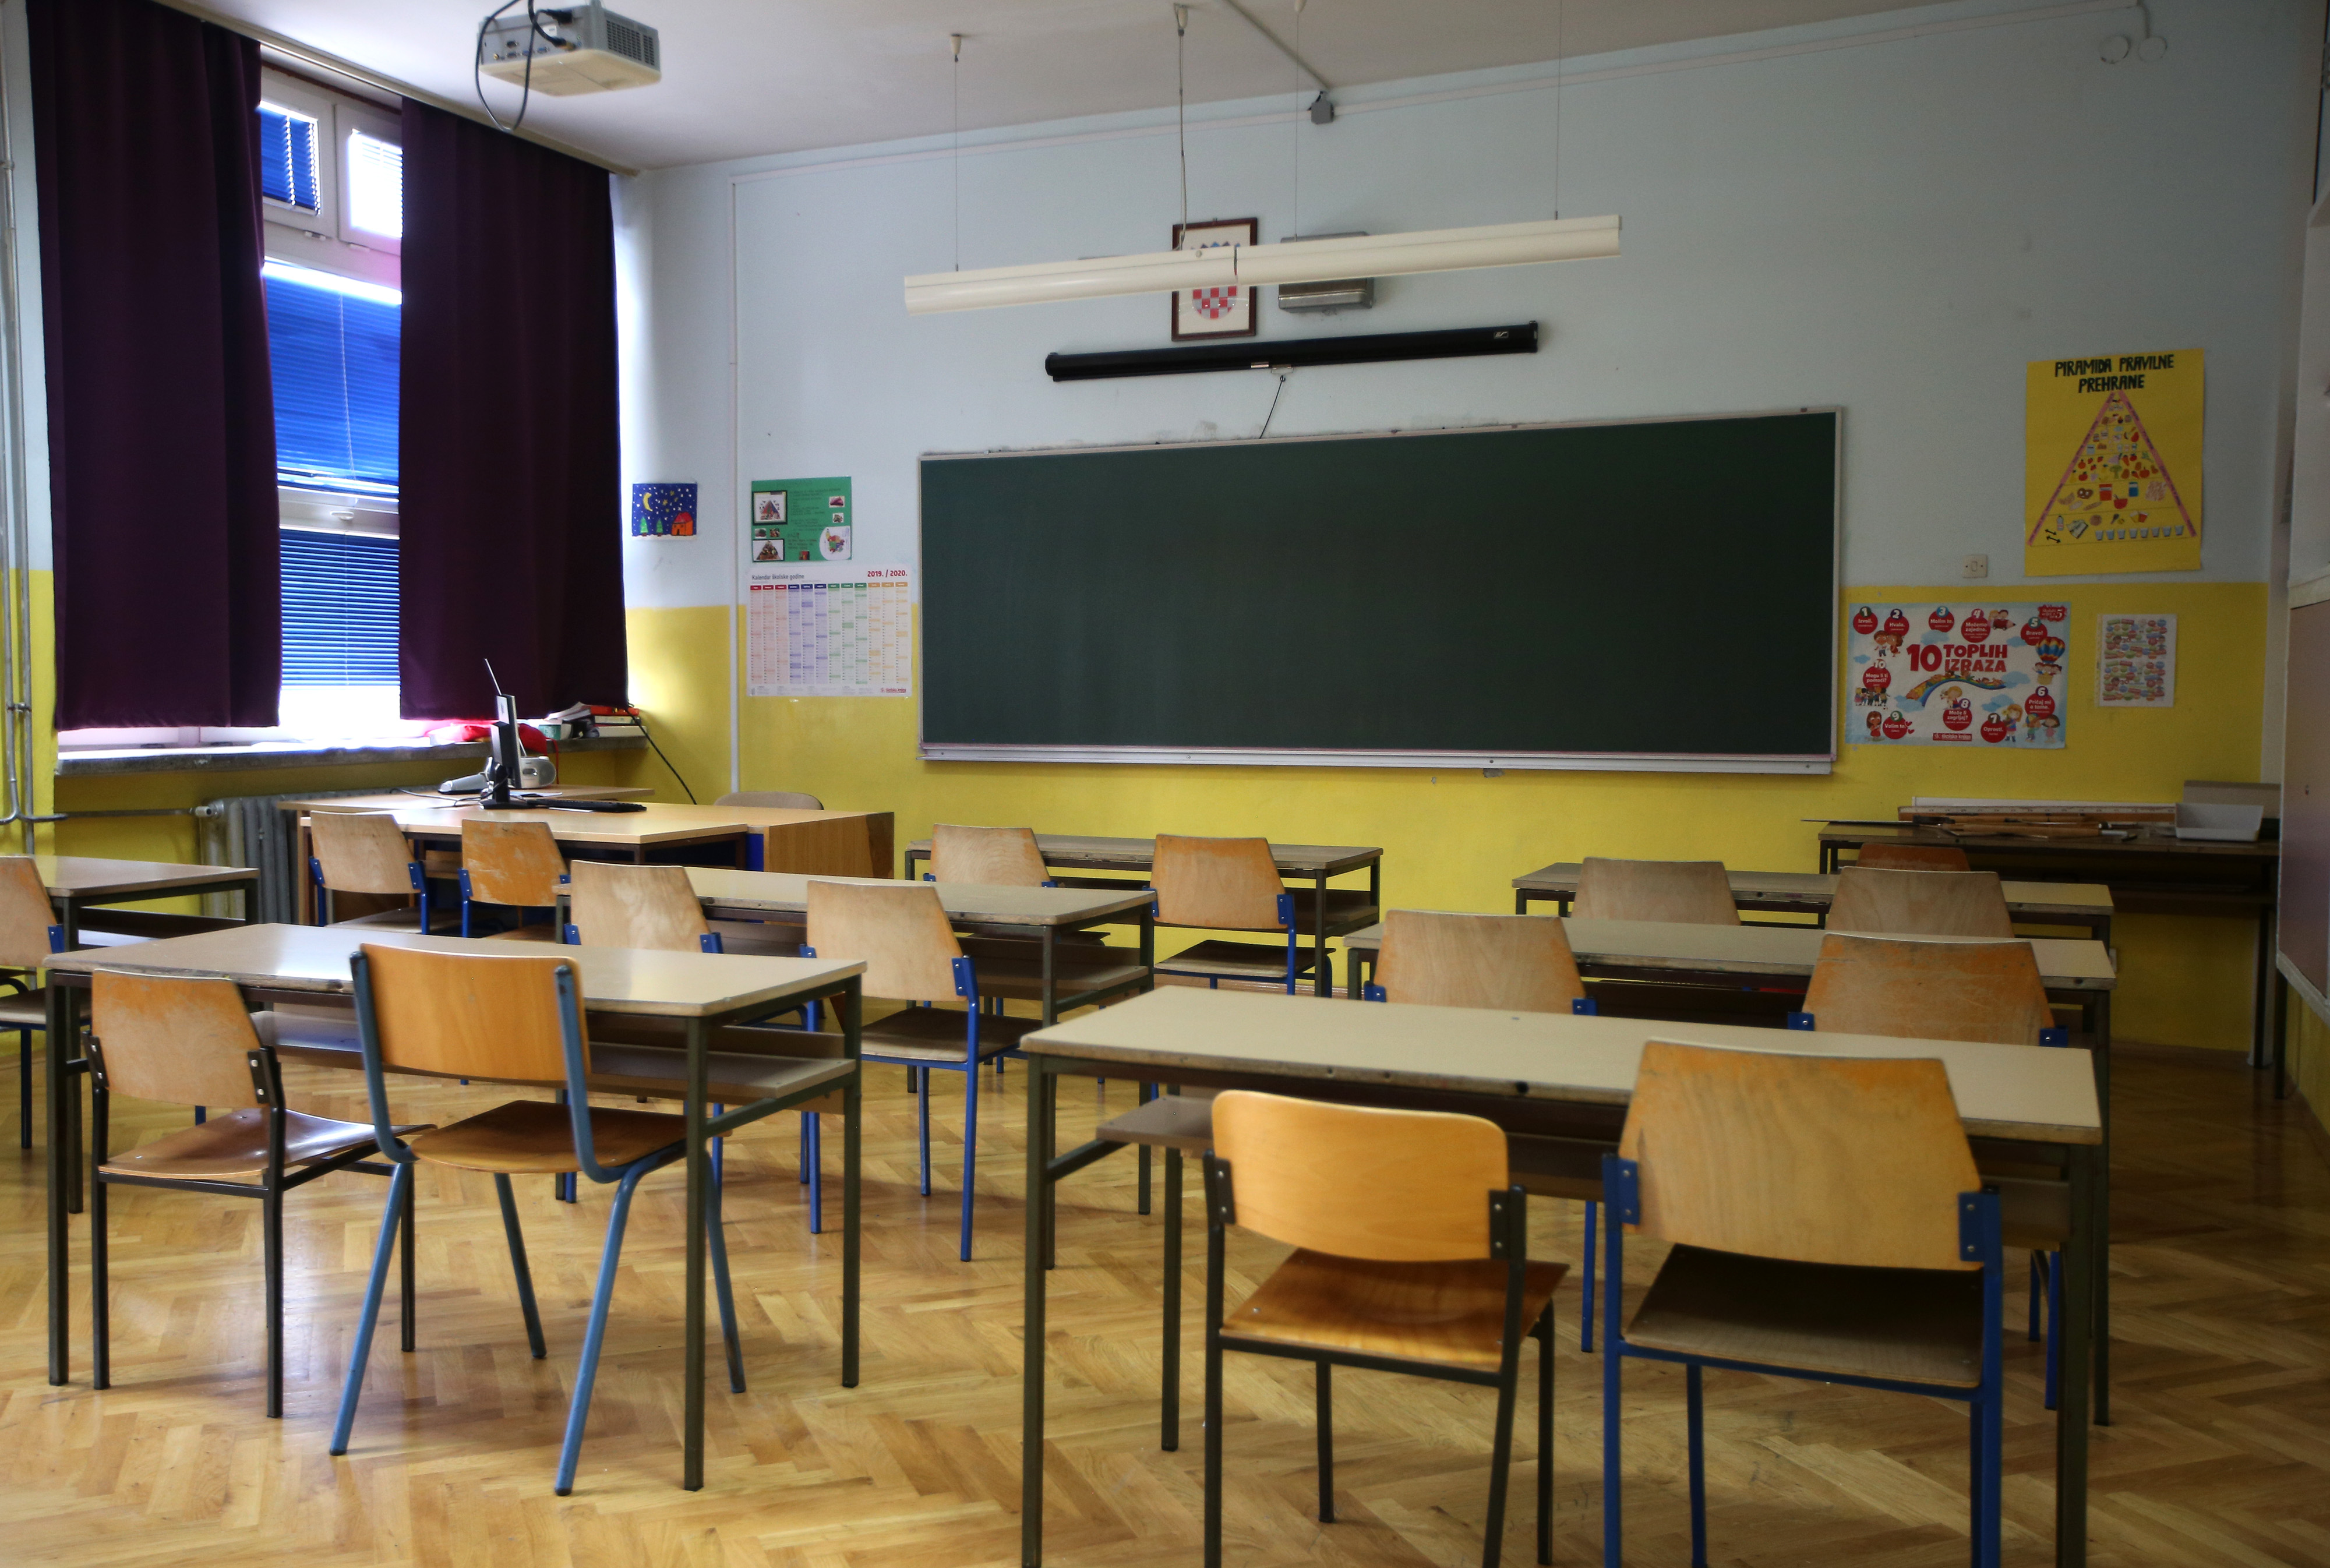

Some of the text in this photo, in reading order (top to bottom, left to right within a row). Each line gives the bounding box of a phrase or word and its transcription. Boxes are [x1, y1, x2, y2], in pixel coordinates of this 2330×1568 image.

[2055, 354, 2174, 377] PIRAMIDA PRAVILNE
[2078, 375, 2145, 393] PREHRANE
[1862, 608, 1867, 616] 1
[1892, 610, 1900, 619] 2
[1939, 607, 1946, 616] 3
[1973, 609, 1981, 619] 4
[2055, 609, 2063, 619] 5
[2030, 618, 2038, 627] 5
[1943, 644, 2007, 658] TOPLIH
[1906, 644, 1943, 672] 10
[1873, 661, 1886, 669] 10
[1944, 659, 2006, 672] IZRAZA
[2038, 687, 2046, 697] 6
[1961, 700, 1969, 708] 8
[1892, 711, 1900, 721] 9
[1990, 714, 1997, 723] 7
